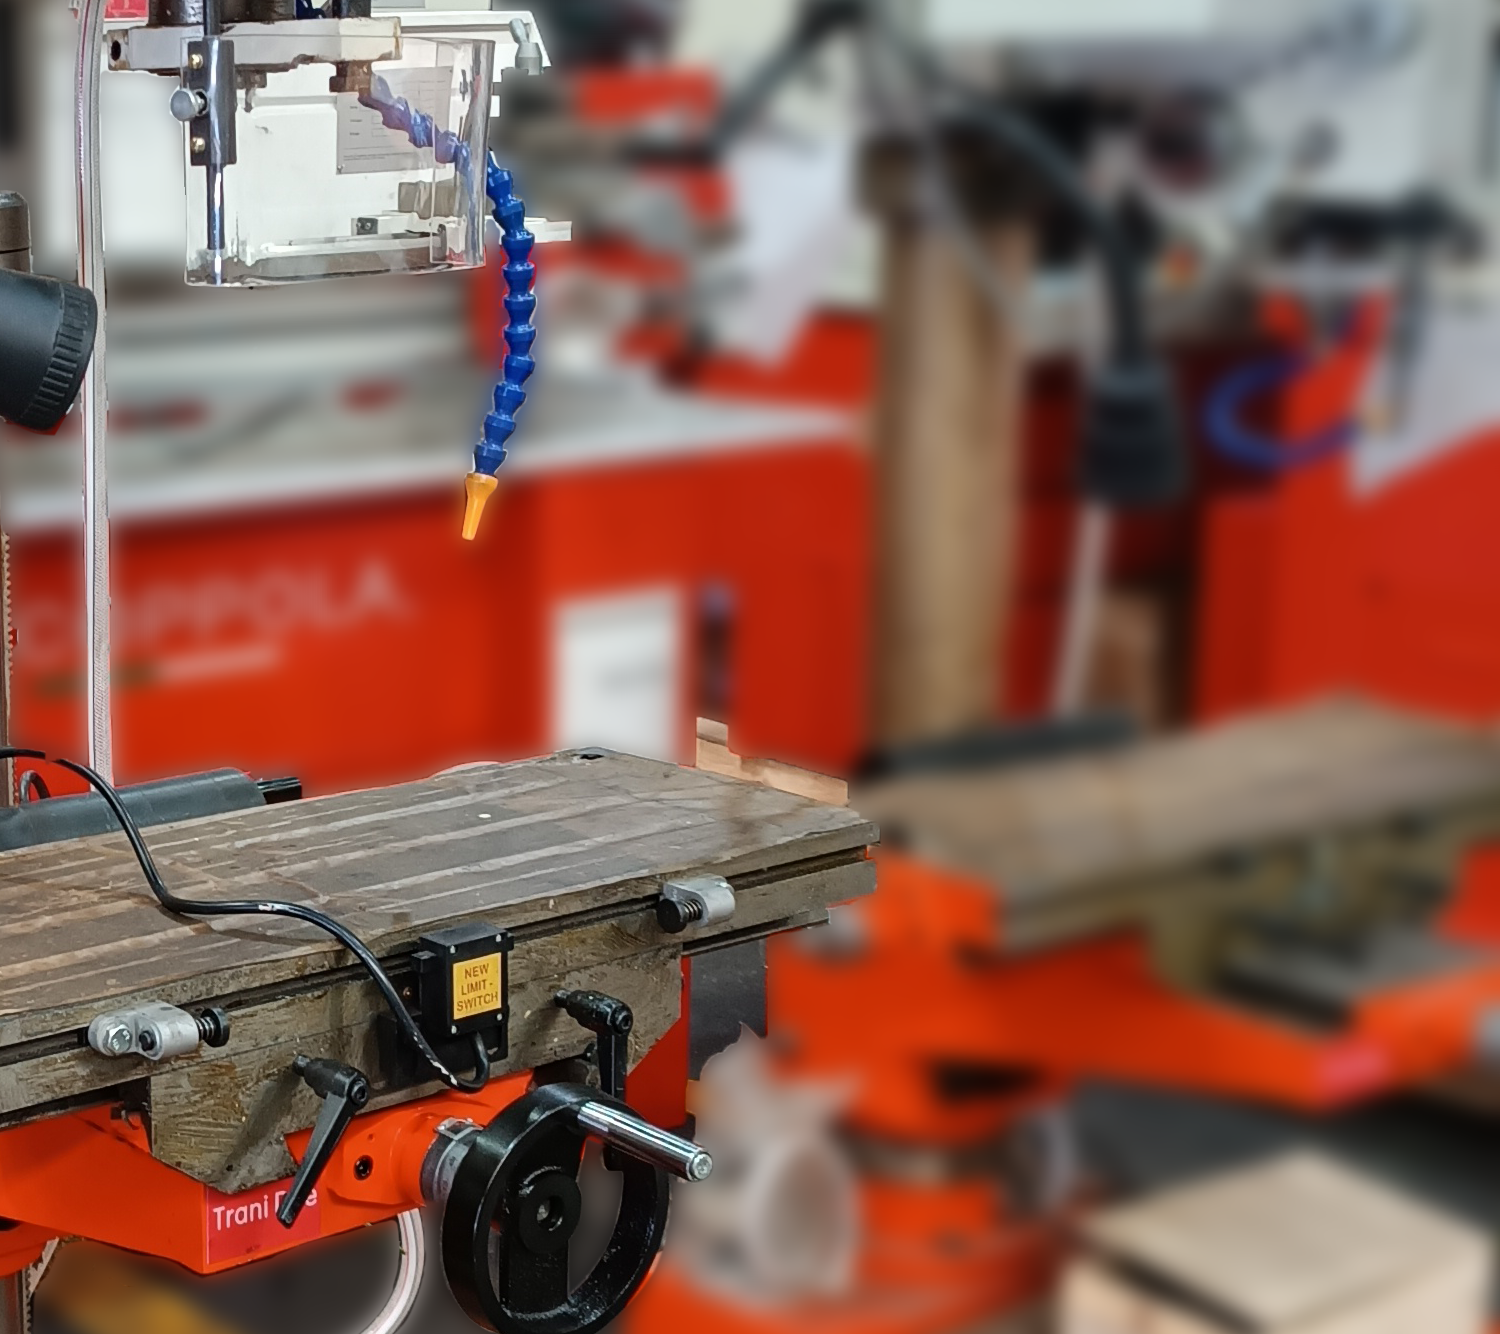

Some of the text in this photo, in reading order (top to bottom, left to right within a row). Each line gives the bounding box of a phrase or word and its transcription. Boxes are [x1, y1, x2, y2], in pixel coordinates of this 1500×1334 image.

[464, 963, 489, 979] NEW
[456, 991, 498, 1012] SWITCH
[212, 1194, 268, 1231] Trani
